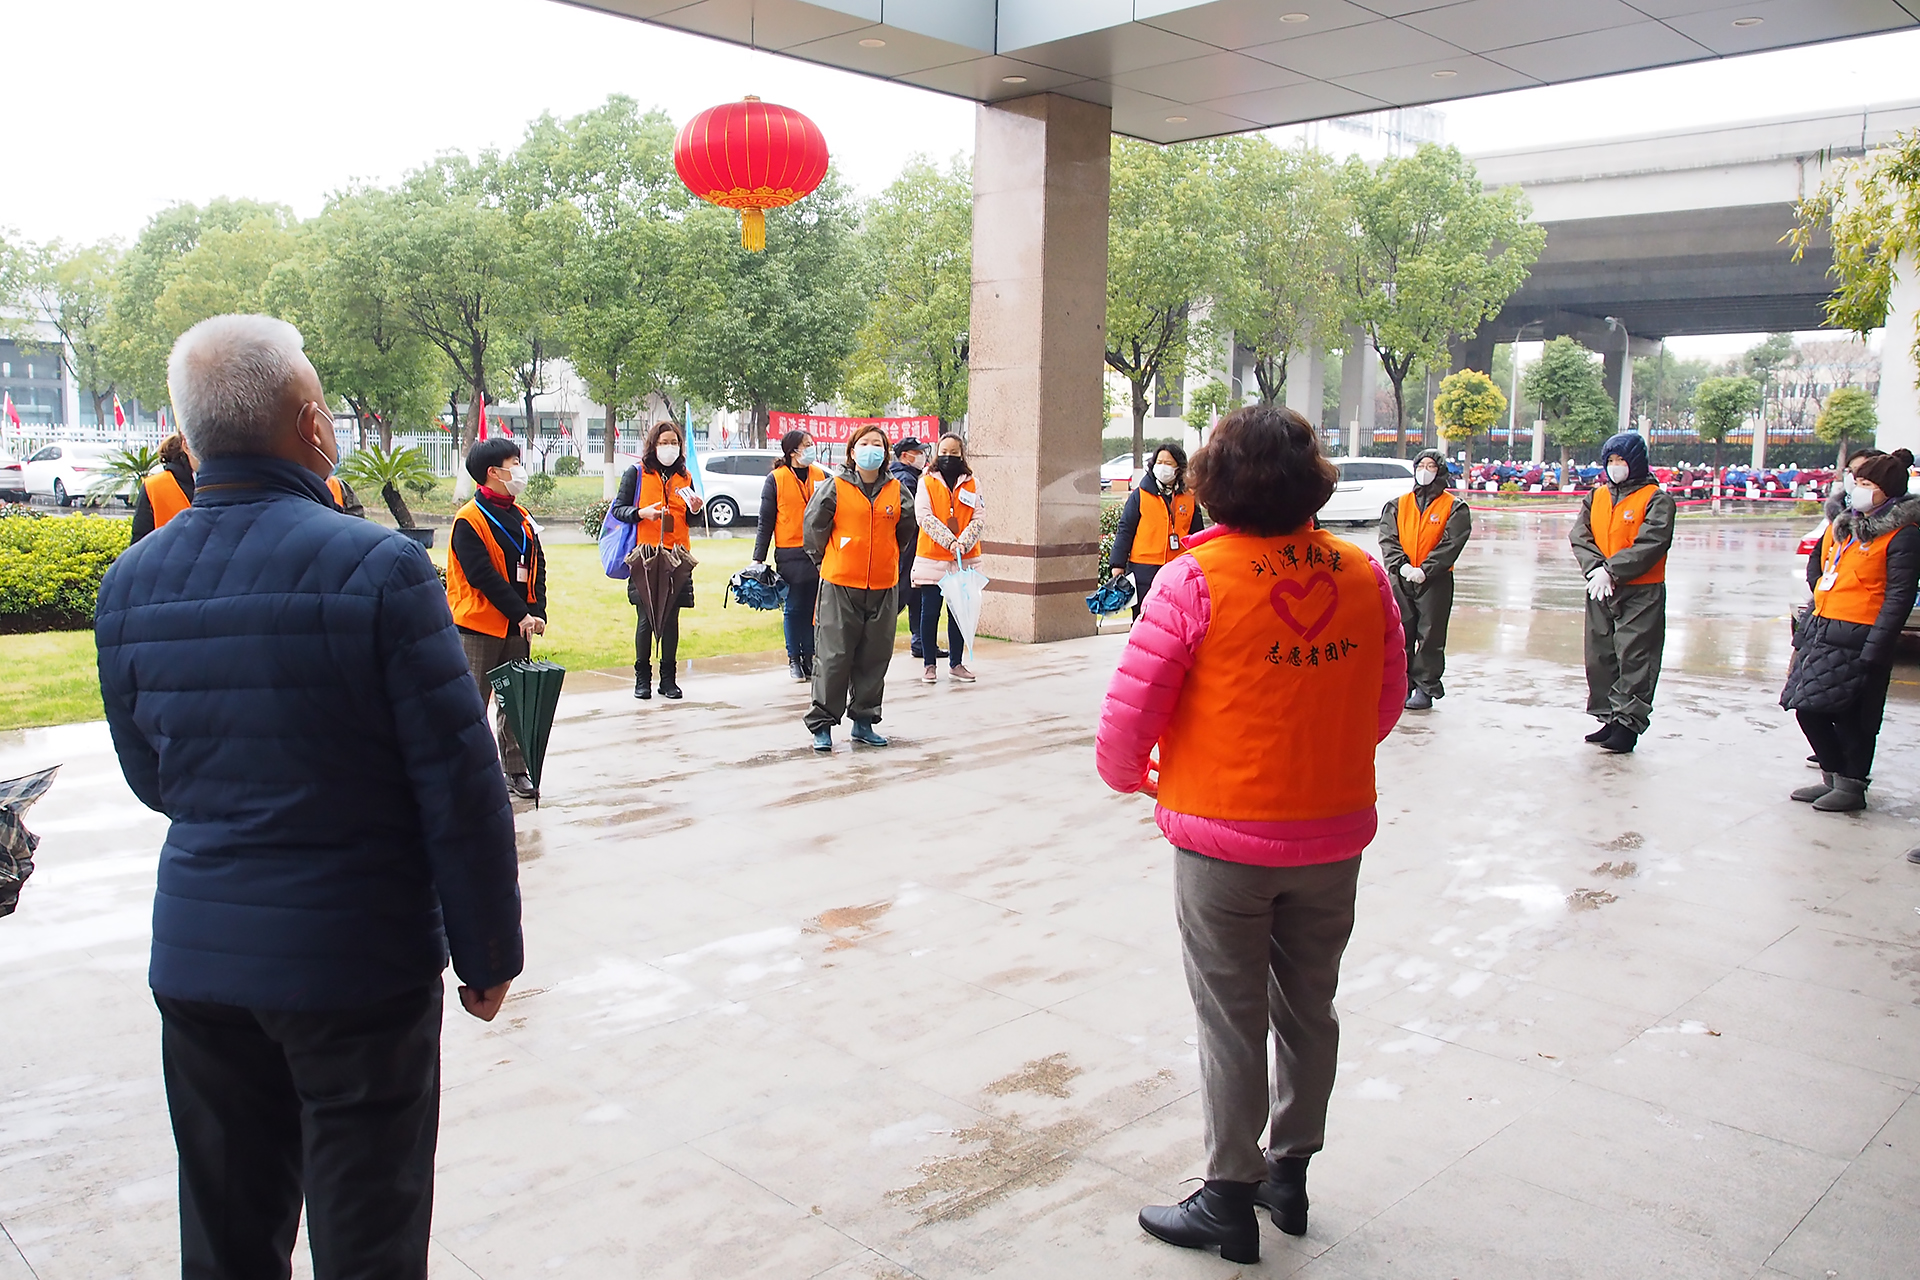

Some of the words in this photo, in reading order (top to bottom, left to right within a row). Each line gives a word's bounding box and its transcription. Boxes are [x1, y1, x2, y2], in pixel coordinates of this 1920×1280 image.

[1250, 543, 1343, 577] 刘潭服装
[1264, 638, 1358, 667] 志愿者团队
